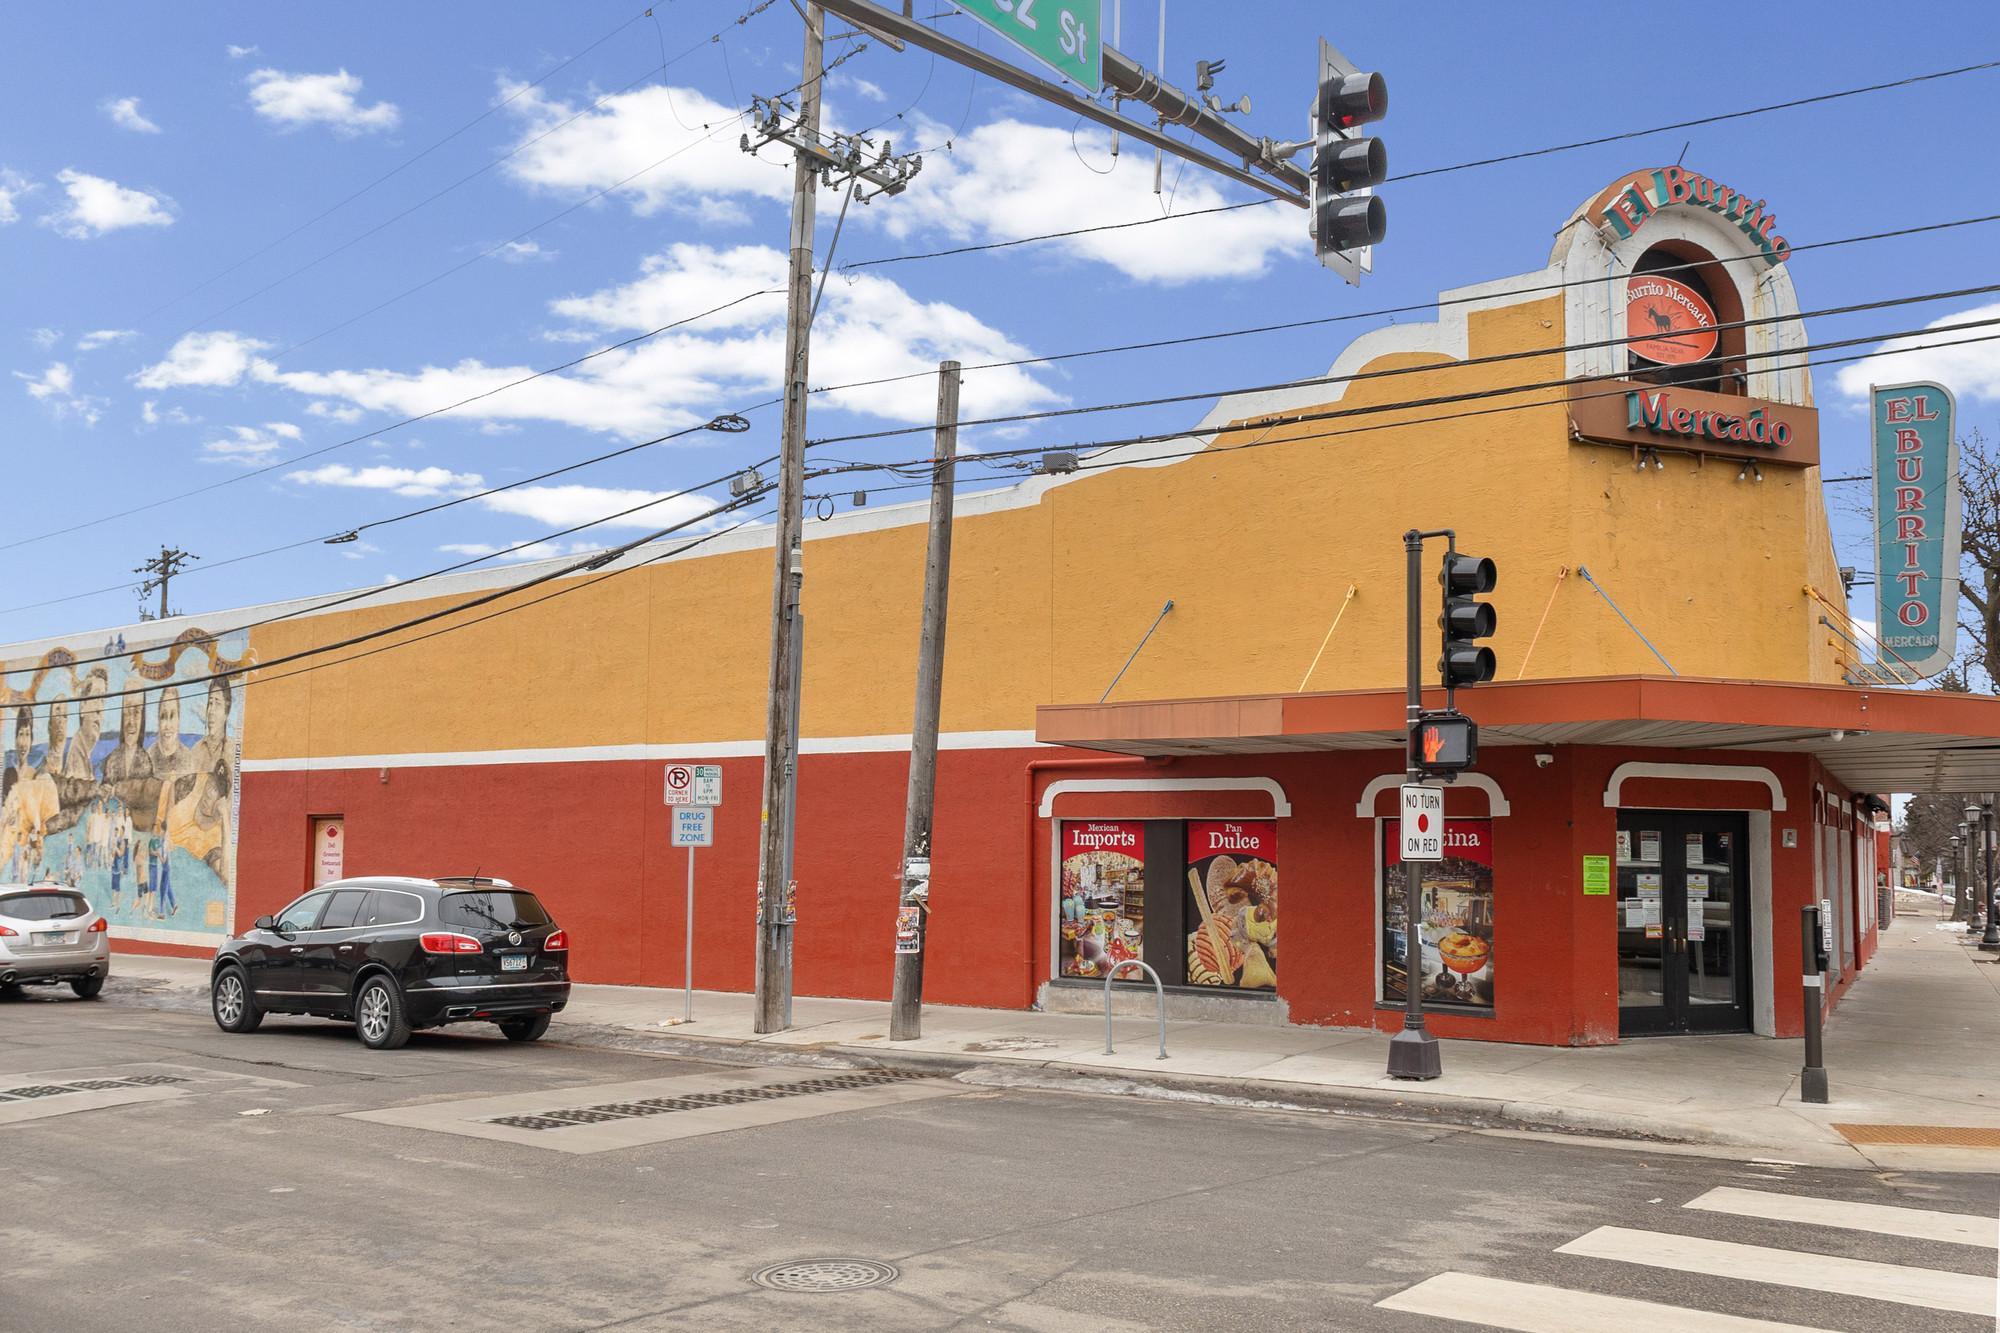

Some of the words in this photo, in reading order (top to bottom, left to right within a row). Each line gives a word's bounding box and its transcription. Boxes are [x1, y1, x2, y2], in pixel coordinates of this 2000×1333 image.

[1059, 10, 1087, 64] St
[1603, 181, 1658, 241] El
[1654, 165, 1791, 266] Burrito
[1625, 282, 1664, 305] Burrito
[1664, 283, 1710, 328] Mercado
[1885, 396, 1939, 424] EL
[1628, 391, 1793, 448] Mercado
[1895, 427, 1928, 627] BURRITO
[1406, 794, 1417, 809] NO
[1421, 793, 1440, 809] TURN
[680, 812, 705, 820] DRUG
[682, 823, 702, 831] FREE
[1088, 823, 1119, 832] Mexican
[1225, 824, 1242, 833] Pan
[680, 833, 705, 841] ZONE
[1073, 829, 1136, 849] Imports
[1209, 832, 1260, 849] Dulce
[1408, 838, 1420, 852] ON
[1422, 838, 1438, 853] RED
